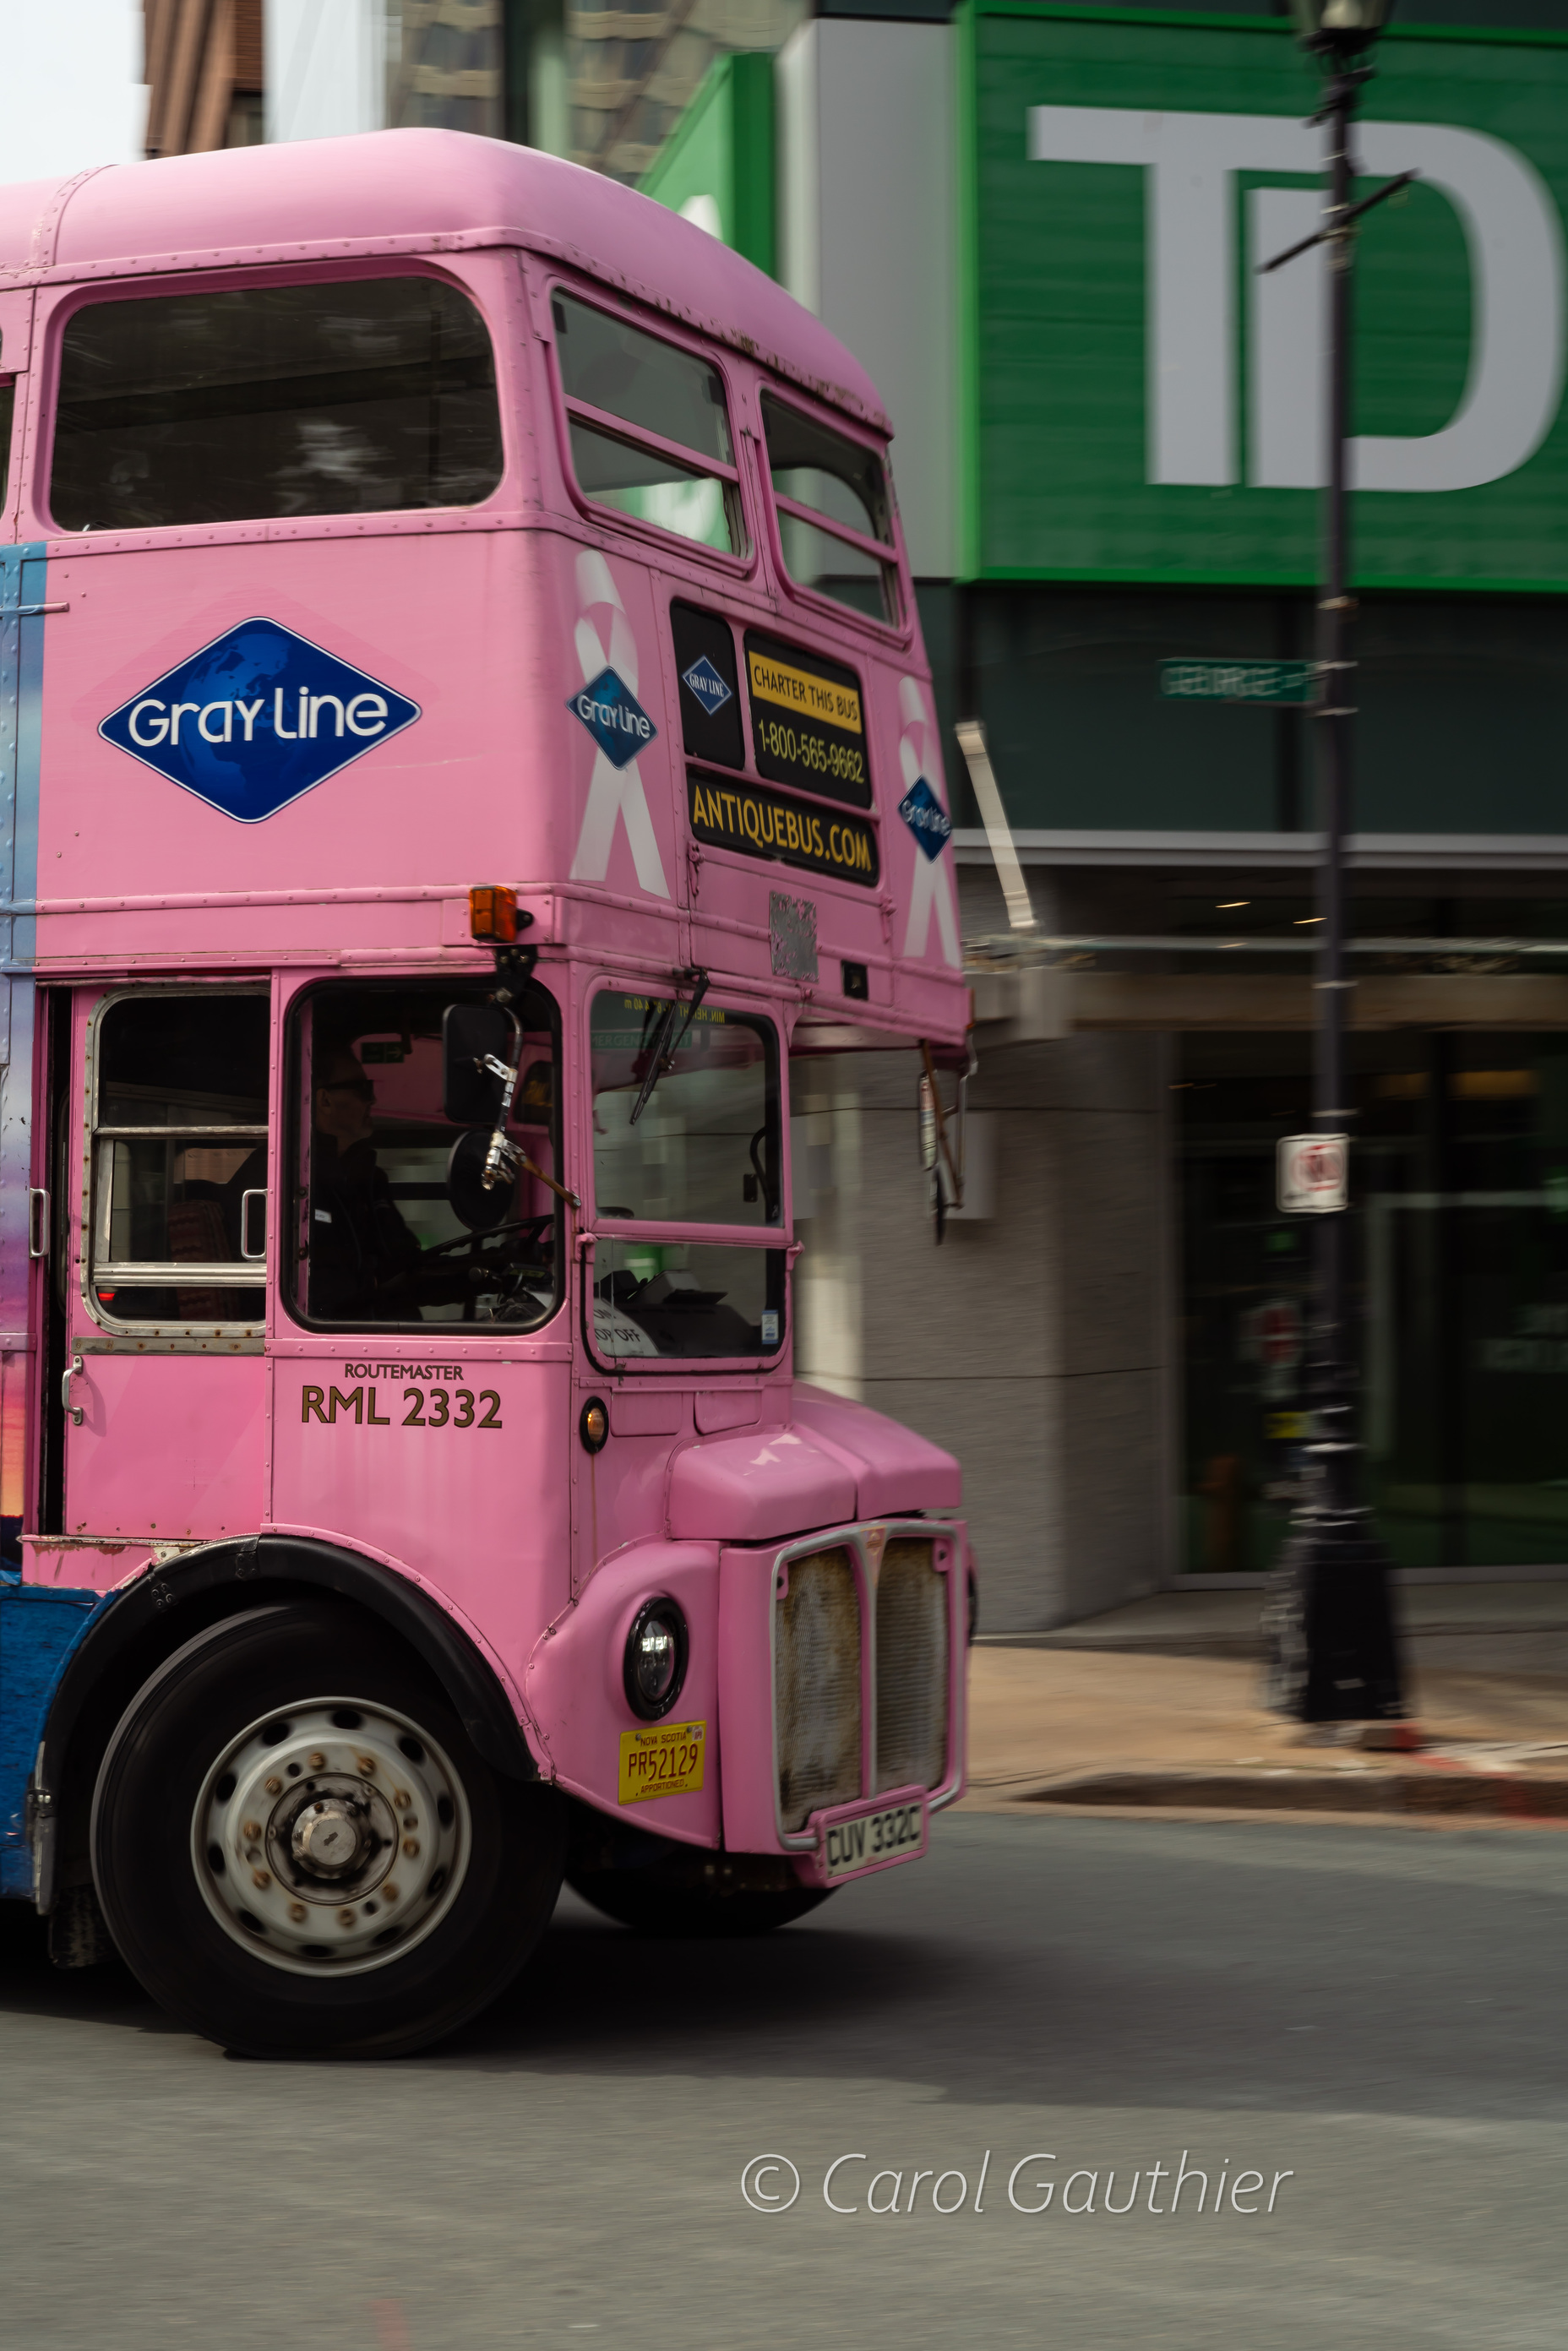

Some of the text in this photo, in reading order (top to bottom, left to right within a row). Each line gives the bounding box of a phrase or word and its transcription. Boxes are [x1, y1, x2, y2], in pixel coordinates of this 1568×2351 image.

[1028, 105, 1564, 492] TD
[689, 673, 724, 698] GRAY LINE
[754, 666, 858, 721] CHARTER THIS BUS
[128, 686, 388, 747] Gray Line
[577, 694, 651, 739] Gray Line
[759, 719, 864, 784] 1-800-565-9662
[693, 784, 872, 872] ANTIQUEBUS.COM
[591, 1034, 658, 1047] MERGENCY
[595, 1328, 640, 1341] OP OFF
[345, 1363, 464, 1380] ROUTEMASTER
[302, 1385, 503, 1429] RML 2332
[640, 1732, 687, 1746] NOVA SCOTIA
[629, 1744, 698, 1782] PR52129
[640, 1778, 684, 1793] APPORTIONED
[826, 1804, 921, 1866] CUV 332C
